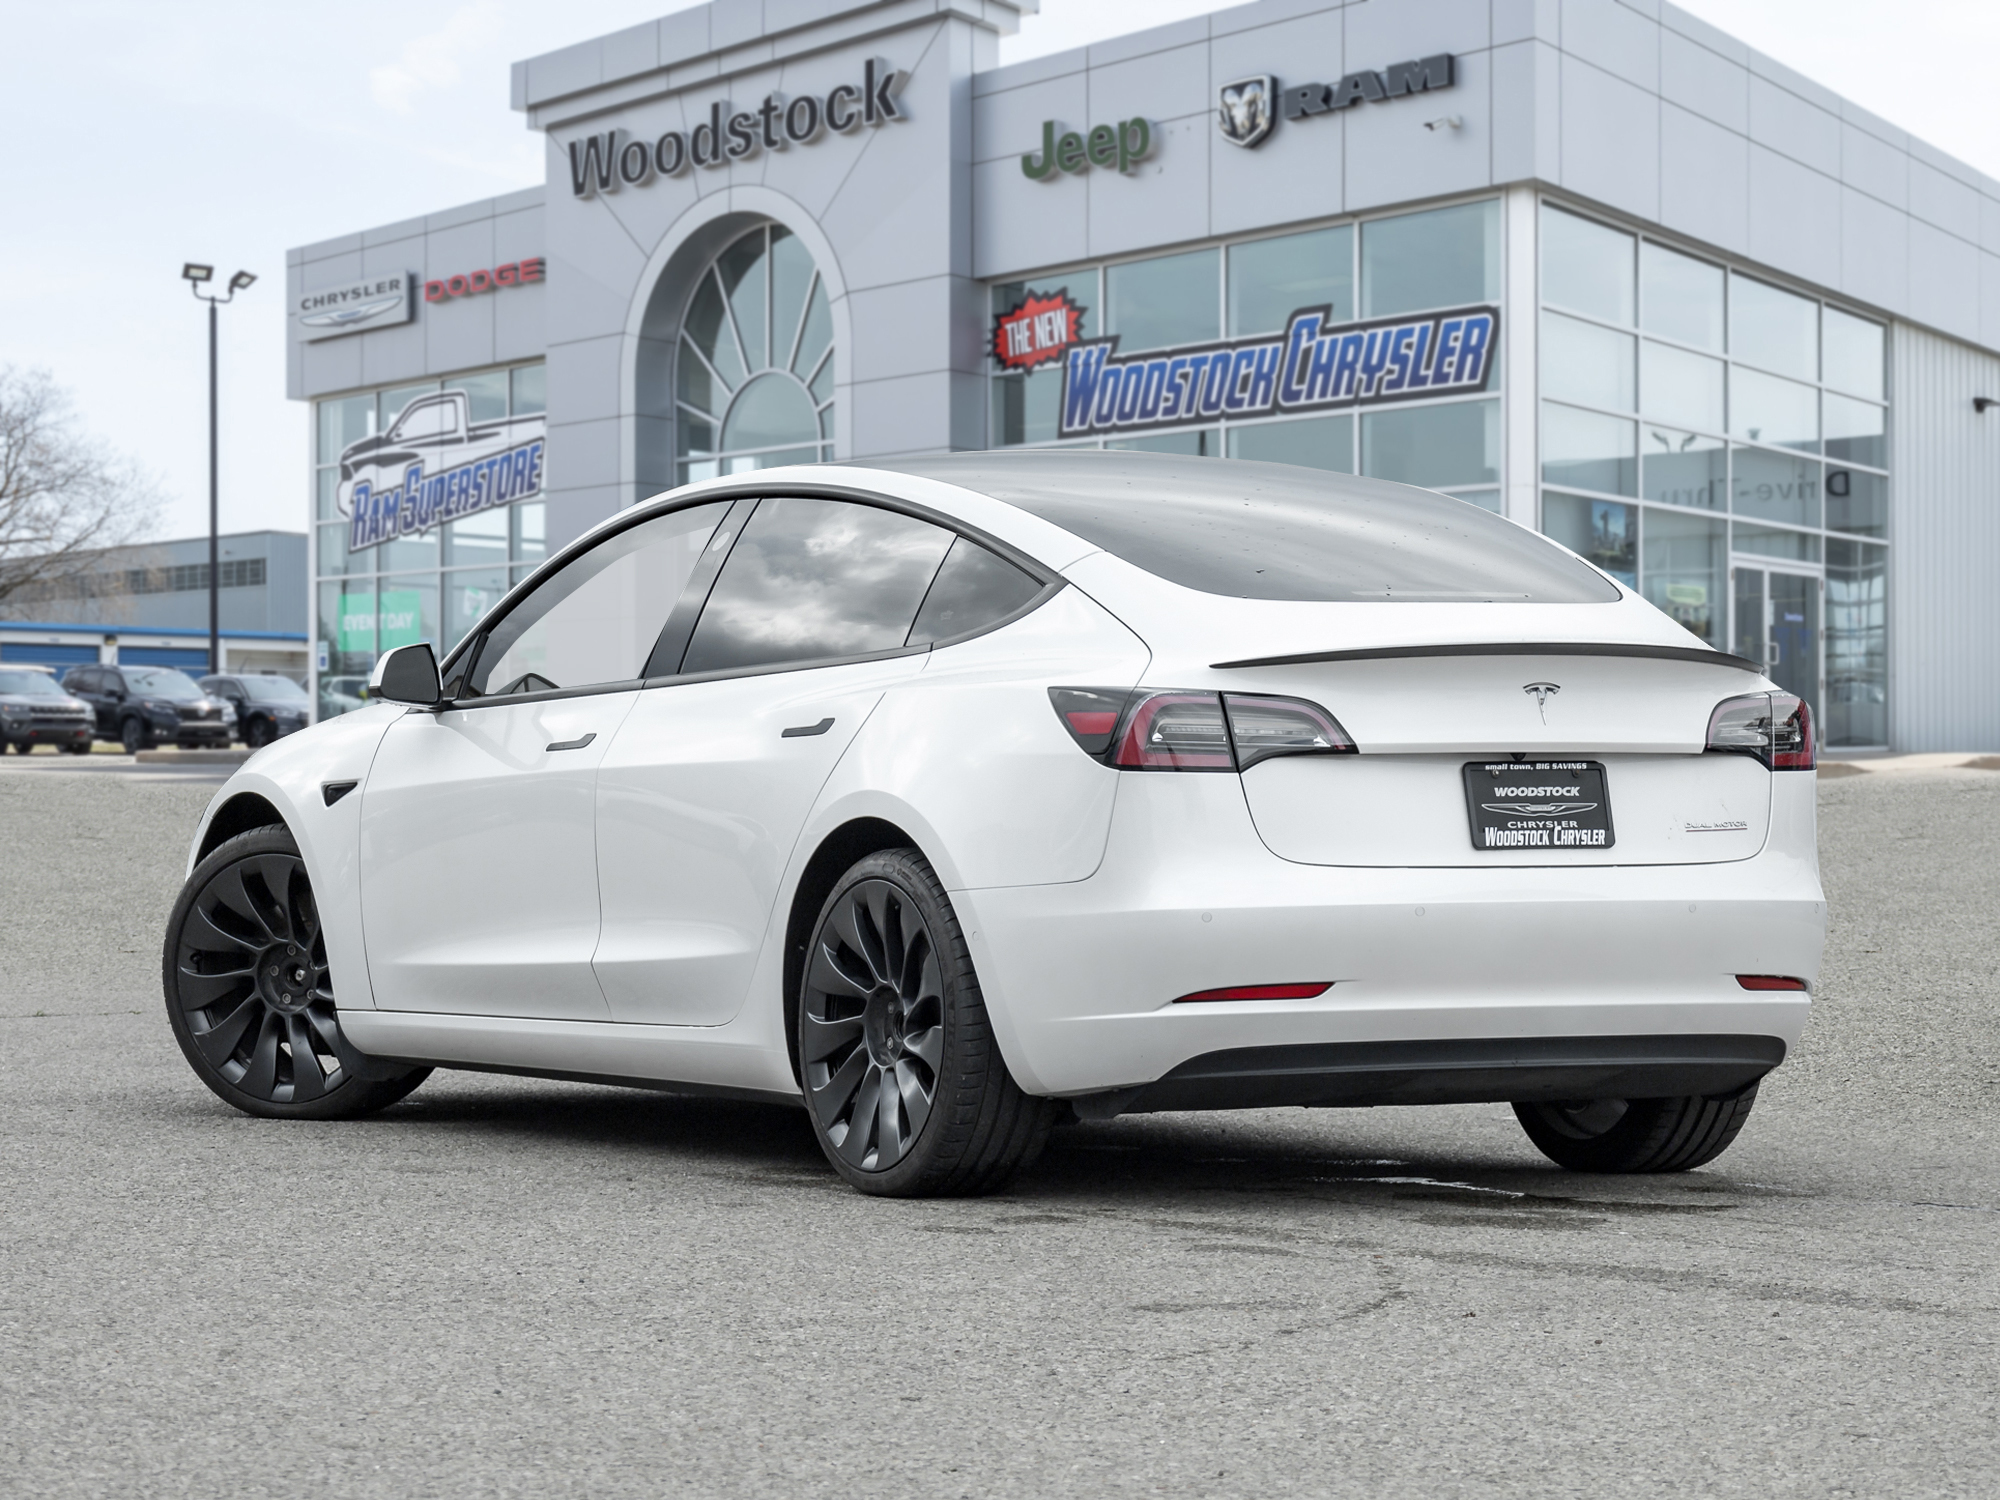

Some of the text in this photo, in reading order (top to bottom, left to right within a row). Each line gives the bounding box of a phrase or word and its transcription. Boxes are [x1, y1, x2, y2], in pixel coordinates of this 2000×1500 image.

[1283, 54, 1455, 119] RAM
[568, 56, 908, 198] Woodstock
[1021, 116, 1153, 179] Jeep
[300, 278, 402, 311] CHRYSLER
[425, 257, 545, 302] DODGE
[1004, 307, 1069, 359] THE NEW
[1063, 313, 1494, 432] WOODSTOCK CHRYSLER
[352, 443, 542, 549] RAM SUPERSTORE
[387, 611, 414, 630] DAY
[1494, 787, 1580, 797] WOODSTOCK
[1485, 826, 1606, 847] WOODSTOCK CHRYSLER
[1507, 820, 1578, 829] CHRYSLER
